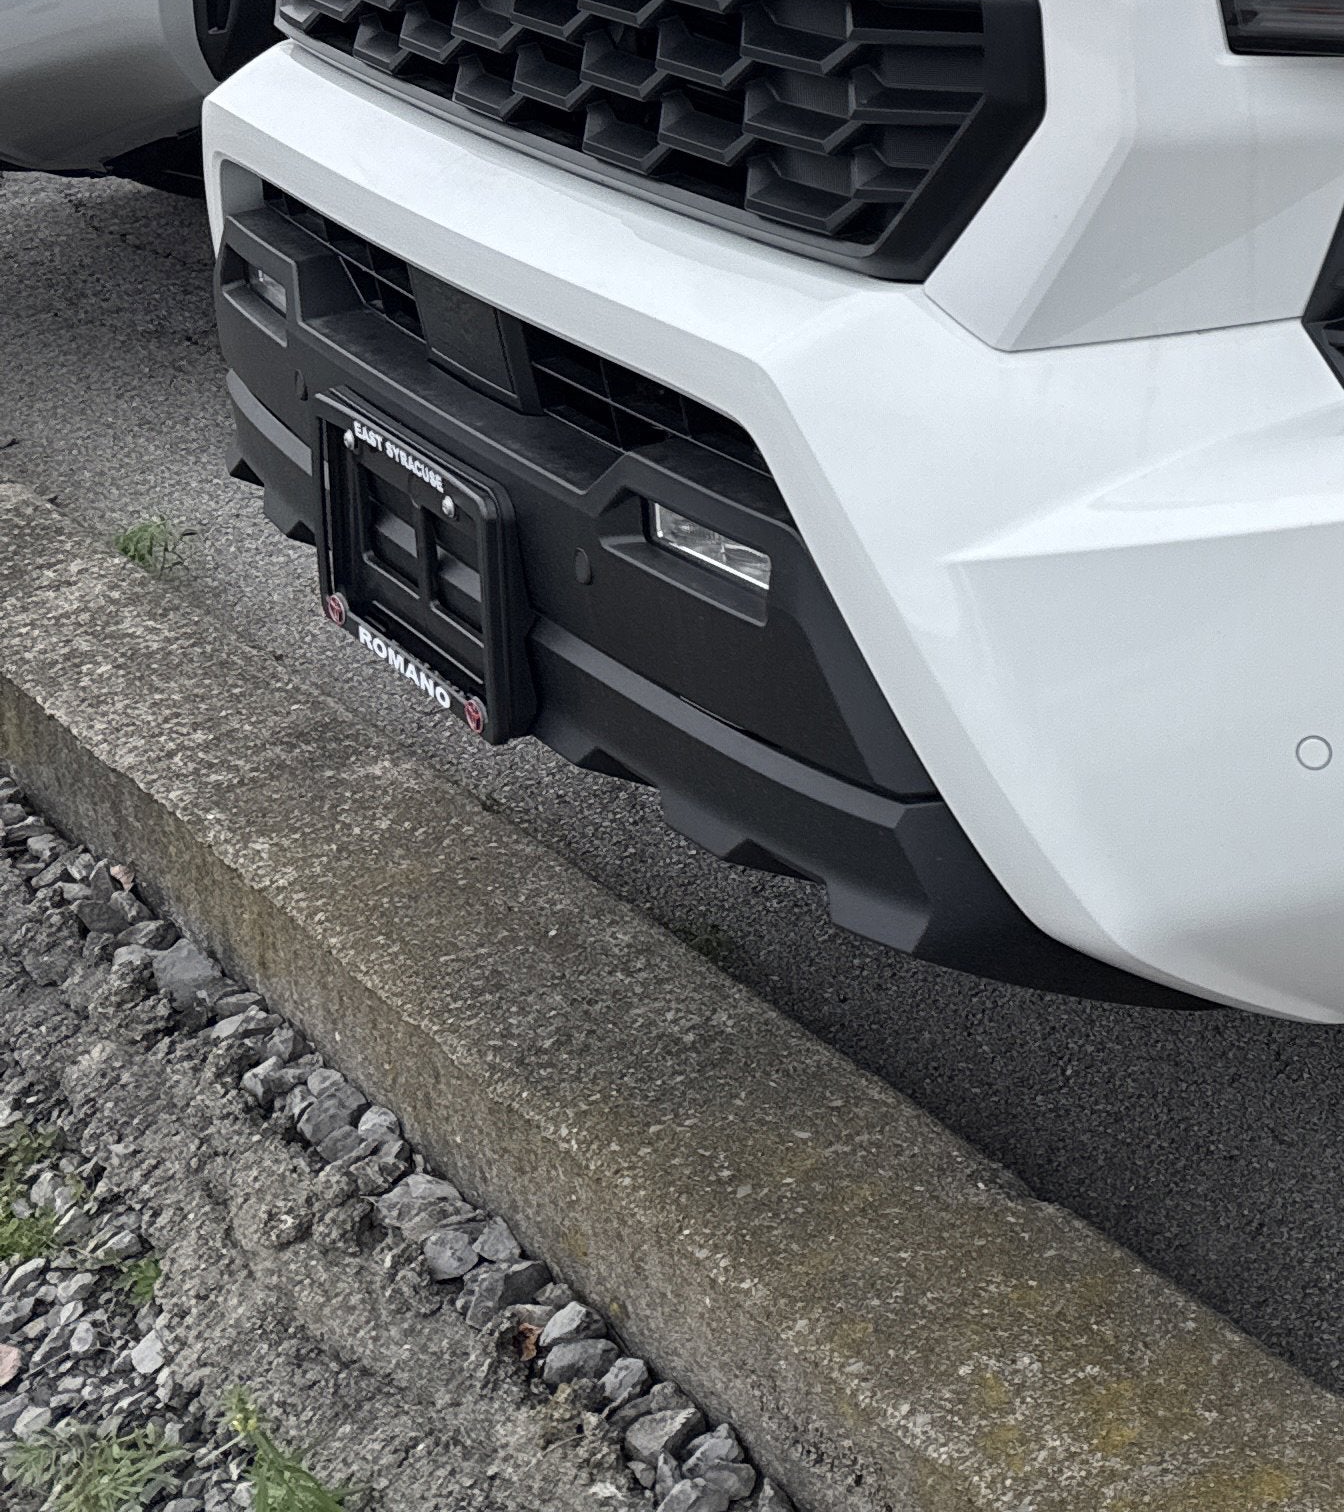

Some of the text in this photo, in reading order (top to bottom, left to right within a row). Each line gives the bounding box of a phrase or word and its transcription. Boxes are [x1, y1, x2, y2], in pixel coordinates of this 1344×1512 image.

[353, 420, 444, 493] EAST SYRACUSE
[358, 625, 451, 709] ROMANO
